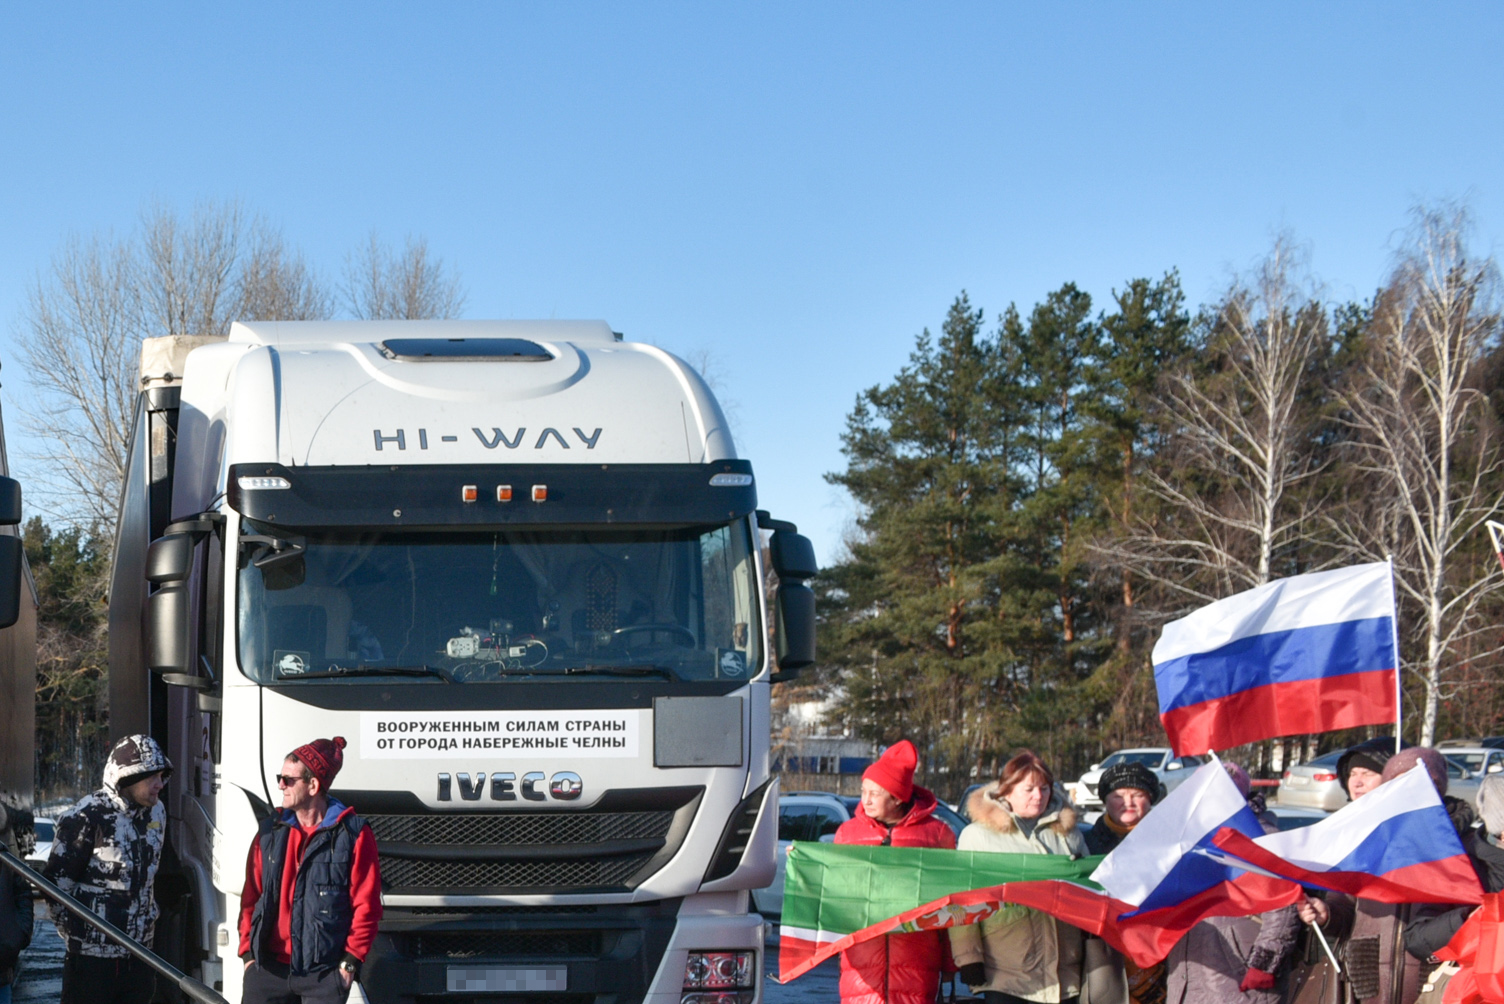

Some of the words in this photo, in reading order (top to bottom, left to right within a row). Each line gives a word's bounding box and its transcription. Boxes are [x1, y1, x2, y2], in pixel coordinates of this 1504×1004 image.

[373, 427, 603, 451] HI-WAY
[377, 721, 500, 732] ВООРУЖЕННЫМ
[506, 720, 560, 732] СИЛАМ
[565, 720, 627, 731] СТРАНЫ
[377, 738, 395, 749] ОТ
[399, 737, 458, 751] ГОРОДА
[462, 737, 568, 749] НАБЕРЕЖНЫЕ
[572, 737, 626, 748] ЧЕЛНЫ
[437, 771, 584, 801] IVECO
